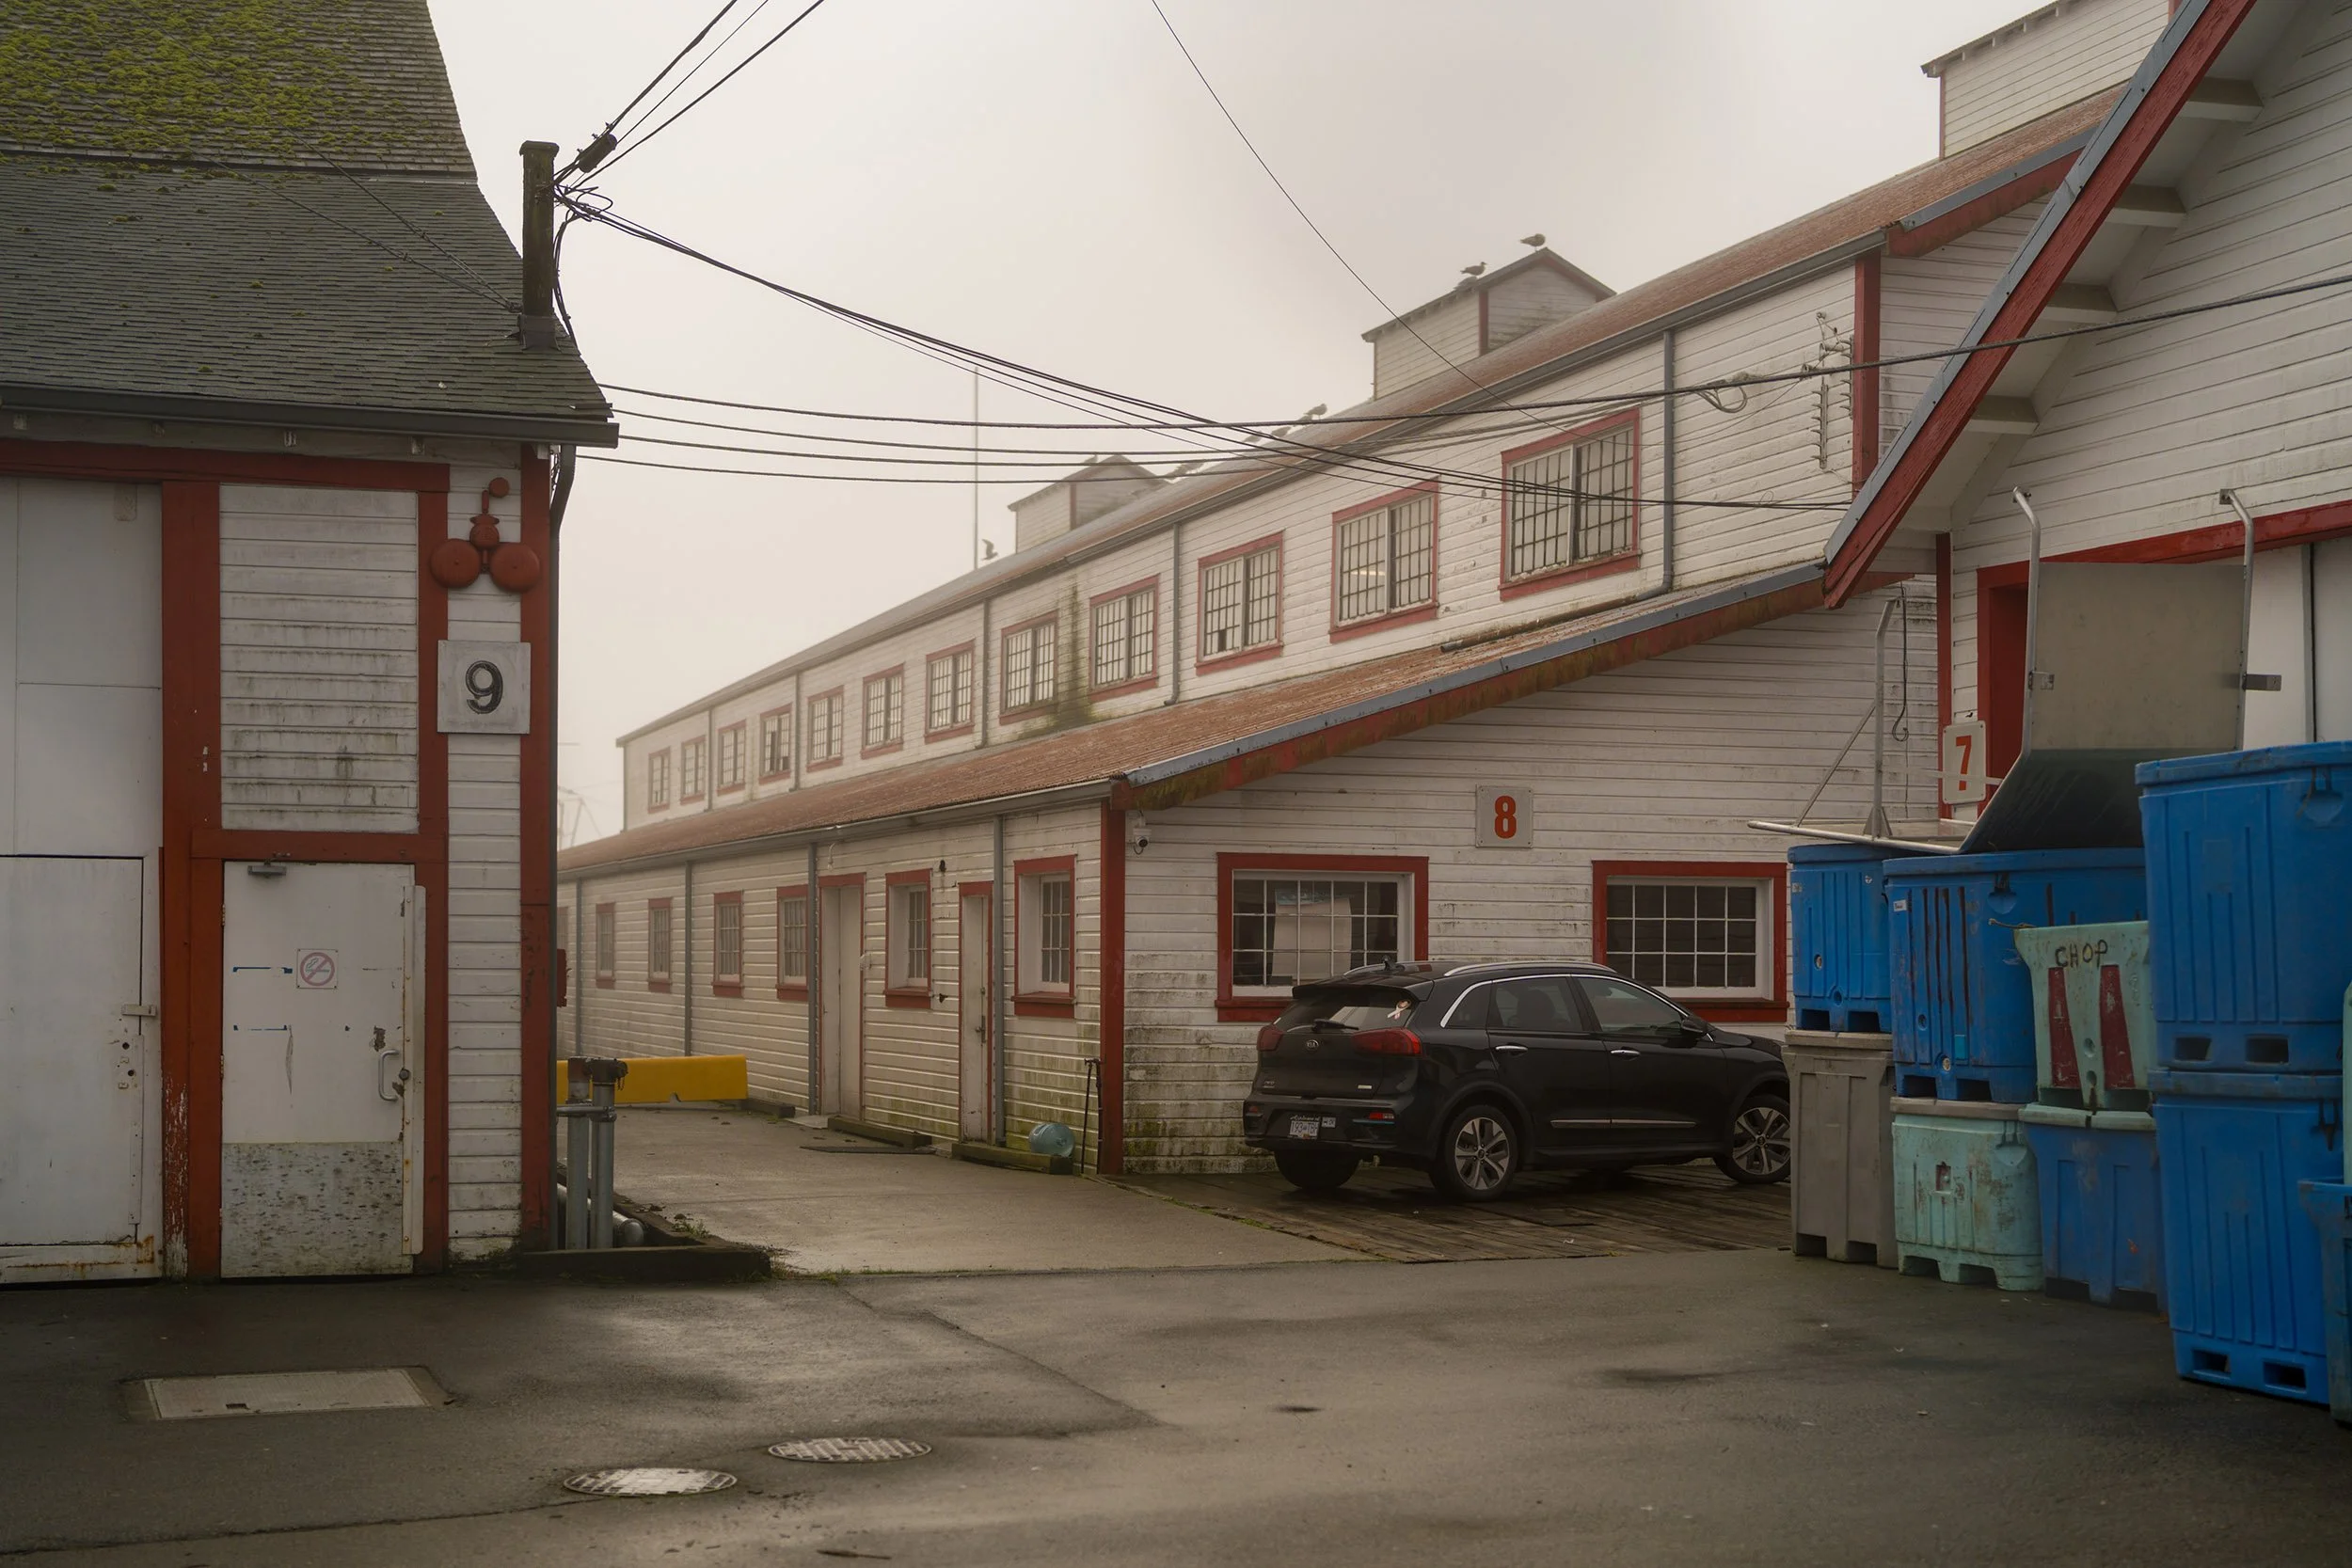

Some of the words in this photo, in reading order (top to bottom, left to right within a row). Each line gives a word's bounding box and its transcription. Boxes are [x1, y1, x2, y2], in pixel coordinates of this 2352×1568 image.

[465, 659, 503, 715] 9
[1955, 735, 1972, 791] 7
[1494, 795, 1518, 839] 8
[2055, 939, 2108, 969] CHOP
